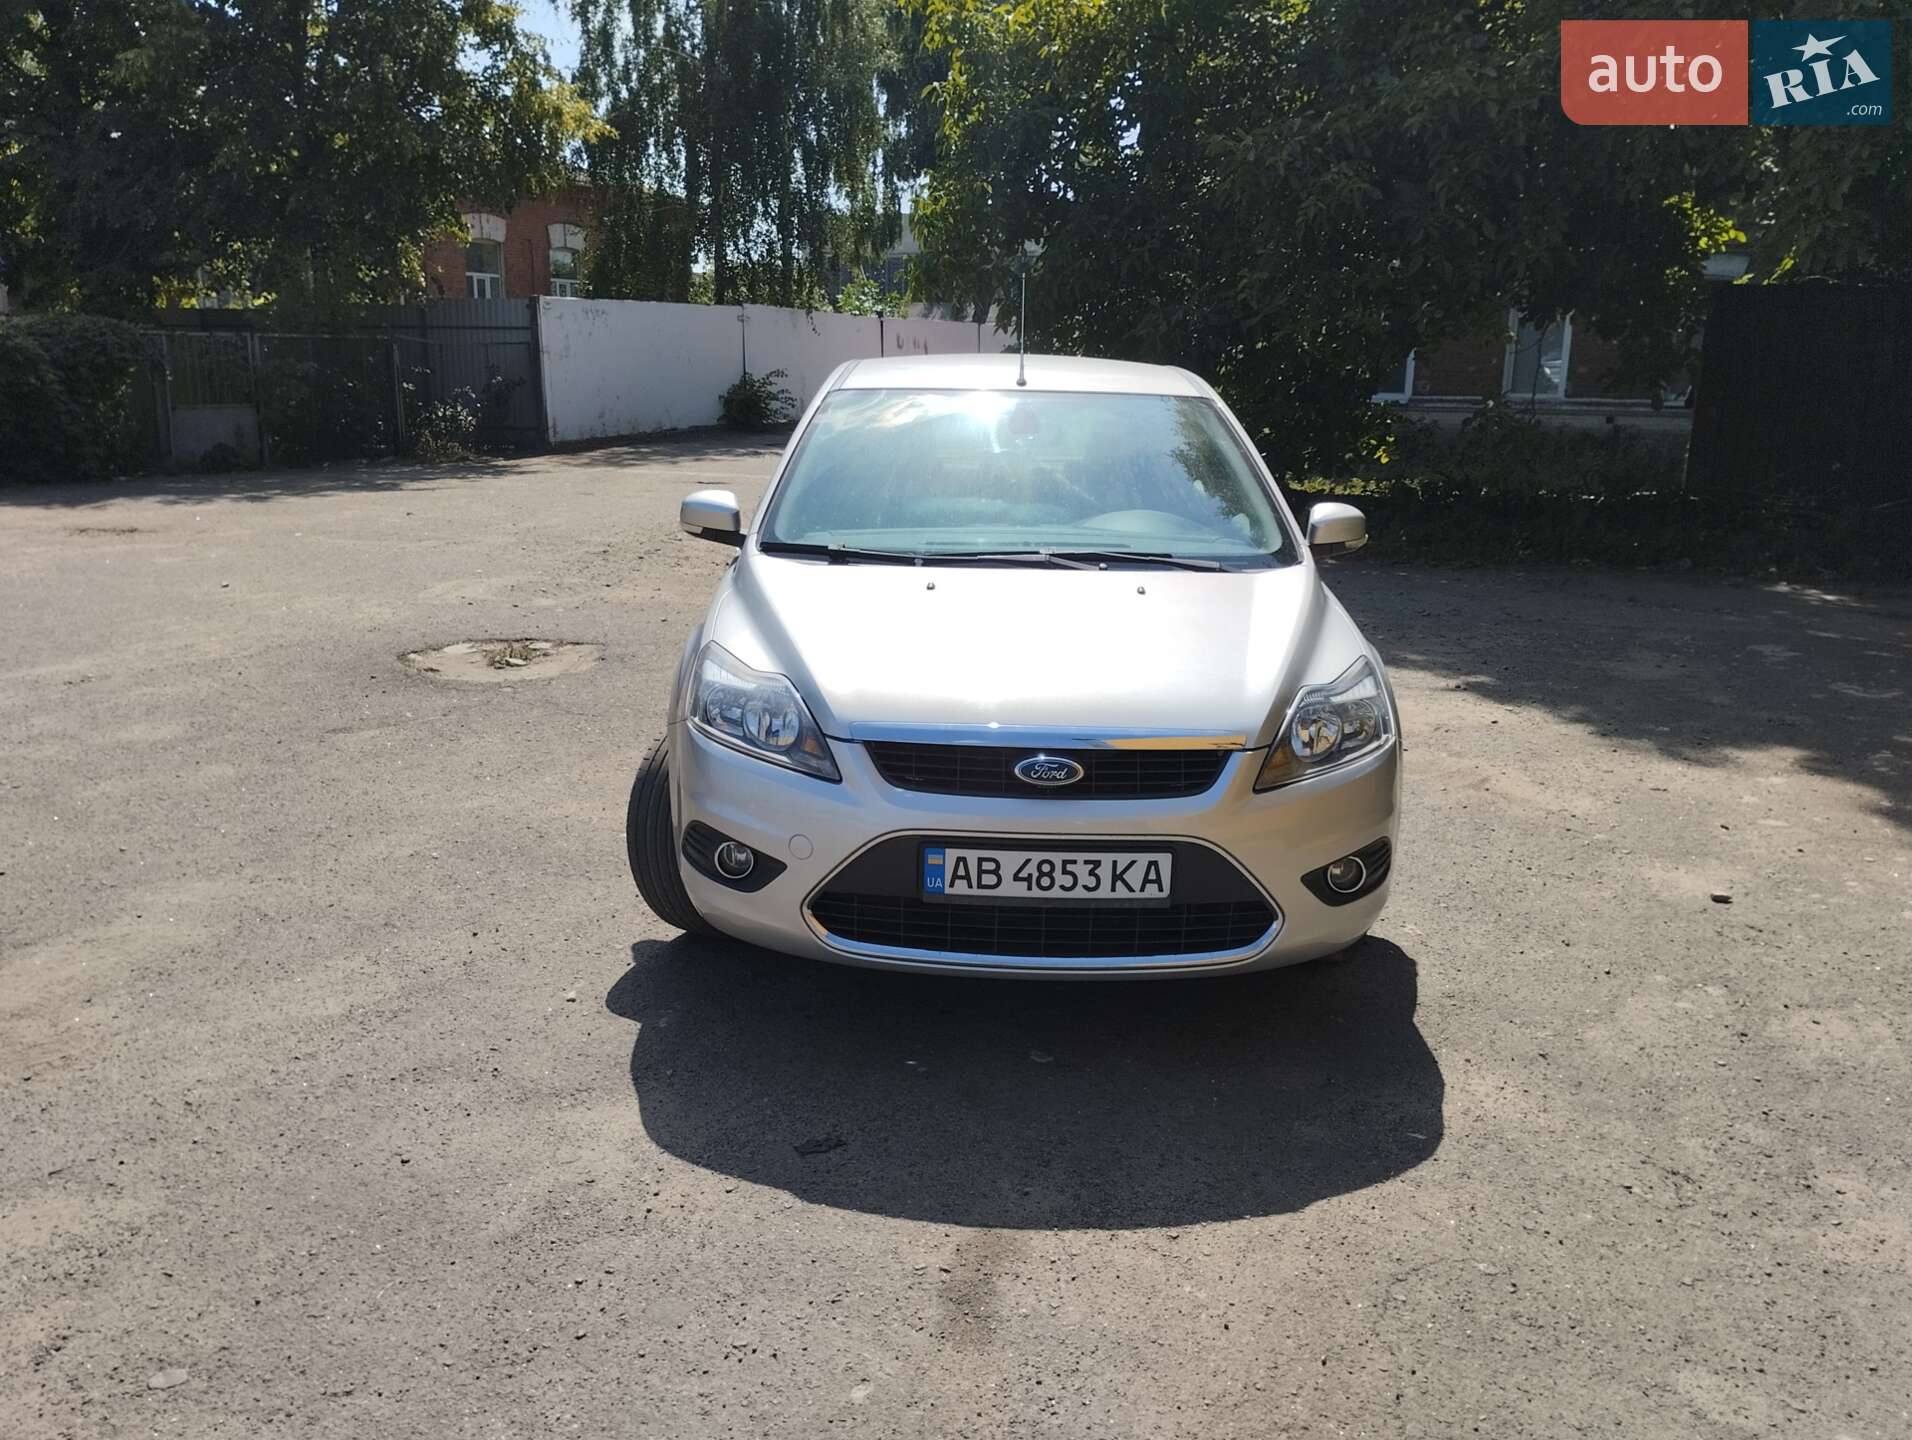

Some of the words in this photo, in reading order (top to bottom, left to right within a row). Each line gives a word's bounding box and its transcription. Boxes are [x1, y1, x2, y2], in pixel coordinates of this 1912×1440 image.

[1030, 763, 1068, 780] Ford
[927, 877, 943, 888] UA
[948, 856, 1003, 890] AB
[1013, 858, 1102, 893] 4853
[1110, 859, 1164, 893] KA
